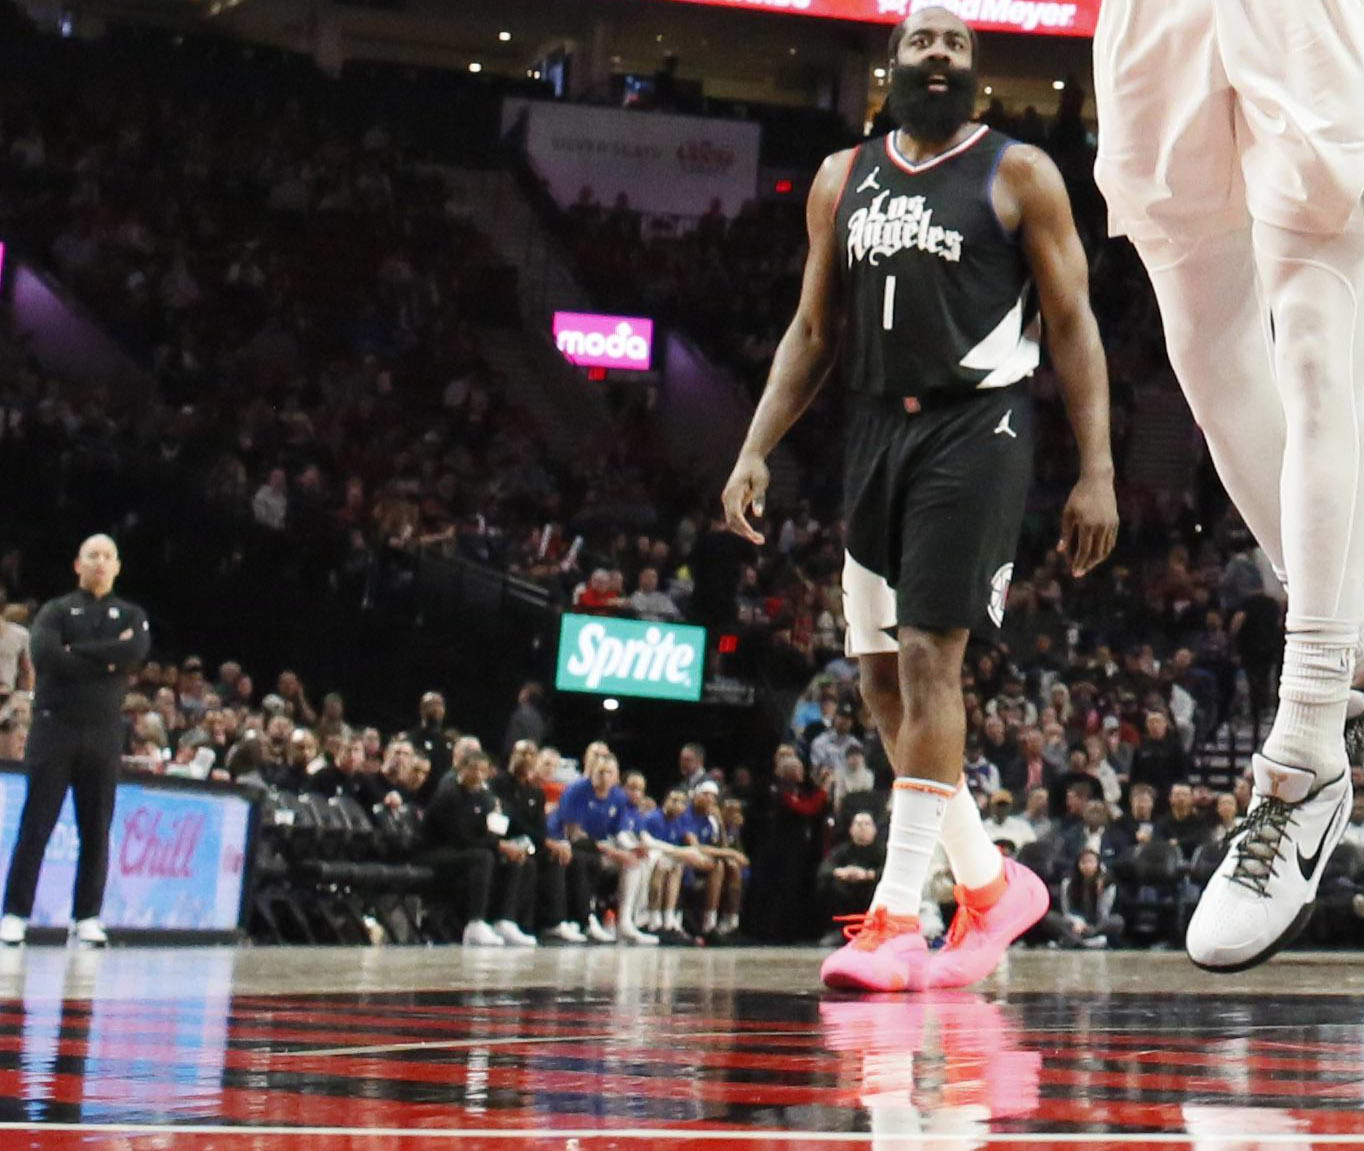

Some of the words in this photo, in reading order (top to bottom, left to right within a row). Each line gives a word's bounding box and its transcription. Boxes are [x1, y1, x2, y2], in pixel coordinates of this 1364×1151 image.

[870, 189, 926, 221] Los
[847, 209, 964, 270] Angeles
[882, 275, 896, 330] 1
[556, 321, 649, 360] moda
[567, 622, 694, 690] Sprite
[119, 806, 206, 878] Chill
